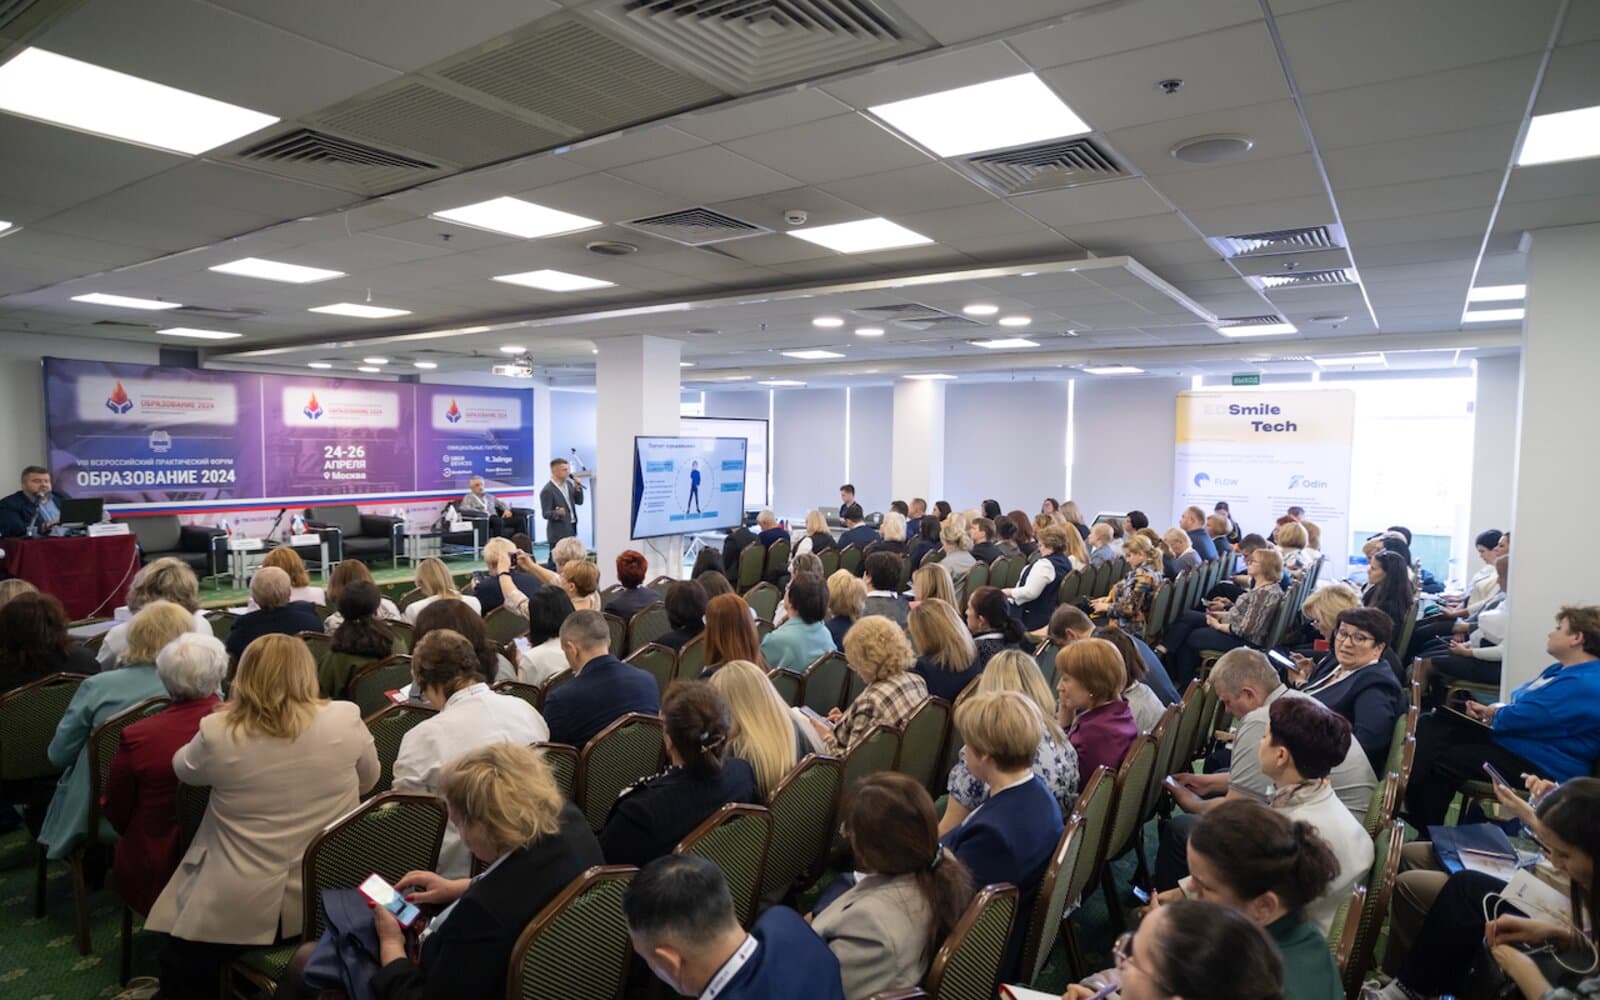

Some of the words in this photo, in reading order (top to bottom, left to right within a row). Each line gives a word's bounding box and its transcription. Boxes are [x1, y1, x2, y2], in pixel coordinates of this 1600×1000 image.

[1251, 421, 1297, 432] Tech
[324, 446, 366, 458] 24-26
[90, 458, 154, 467] ВСЕРОССИЙСКИЙ
[155, 458, 209, 466] ПРАКТИЧЕСКИЙ
[324, 460, 366, 469] АПРЕЛЯ
[77, 470, 198, 486] ОБРАЗОВАНИЕ
[201, 470, 236, 483] 2024
[1302, 480, 1328, 488] Odin
